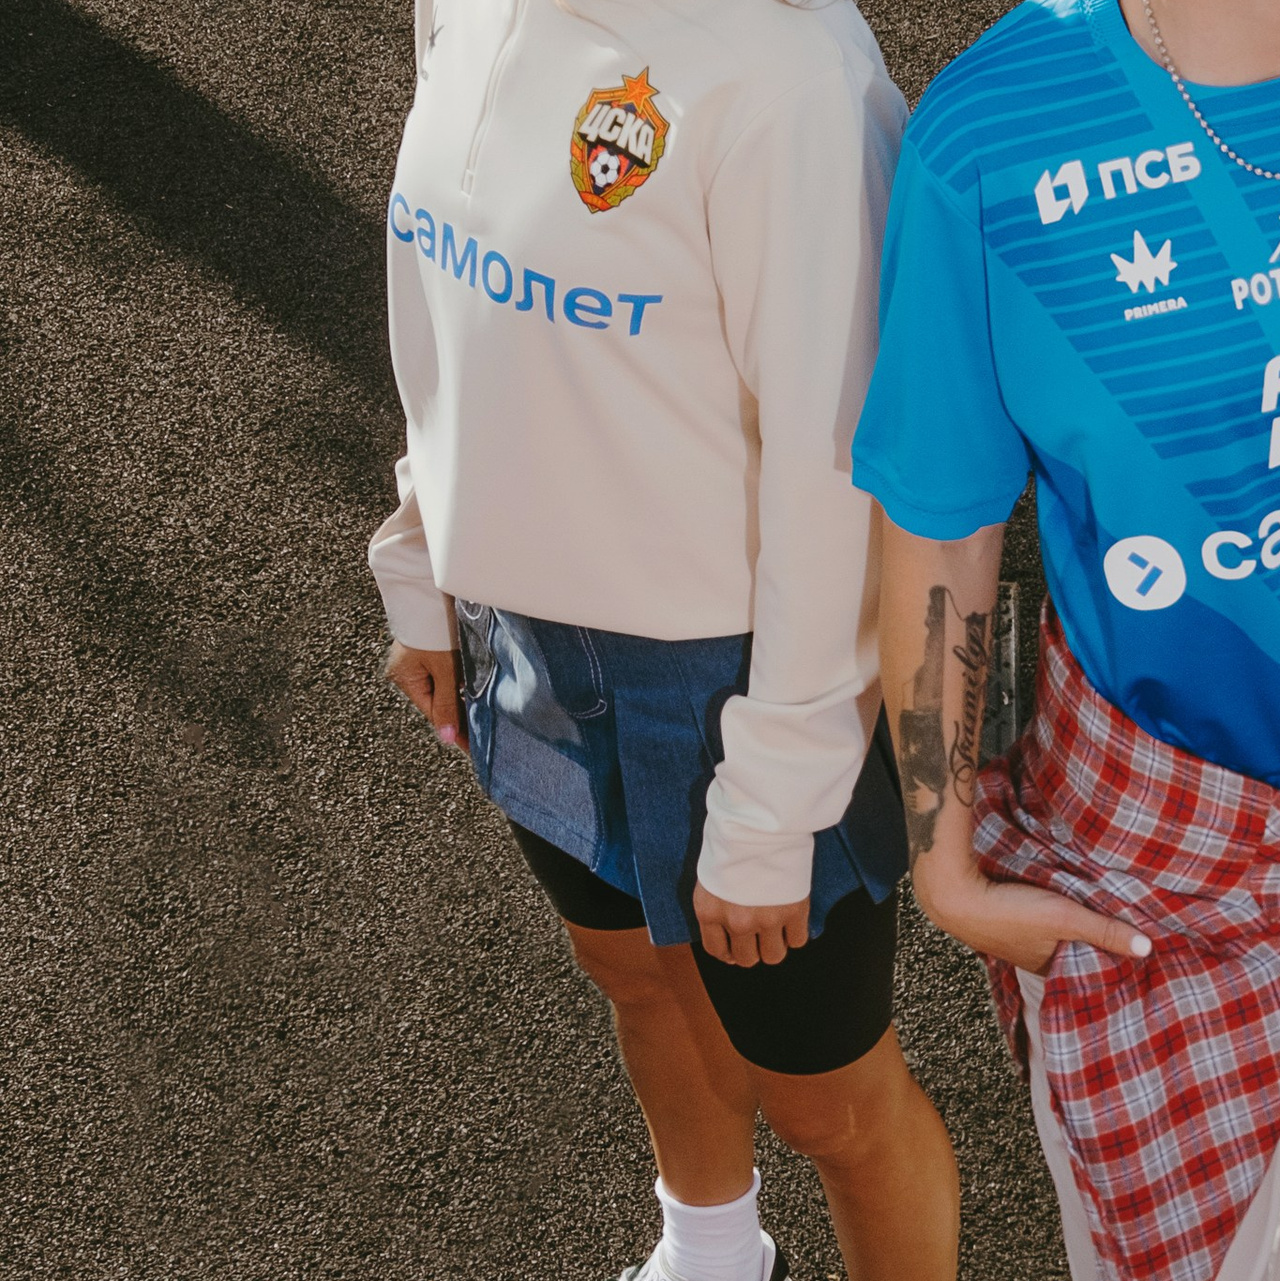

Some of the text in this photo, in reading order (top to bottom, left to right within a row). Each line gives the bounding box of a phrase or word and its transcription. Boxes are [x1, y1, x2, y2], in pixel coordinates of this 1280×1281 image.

[579, 102, 656, 167] ЦСКА
[1098, 141, 1202, 200] ПСБ
[388, 192, 663, 336] самолет
[1124, 296, 1188, 321] PRIMERA
